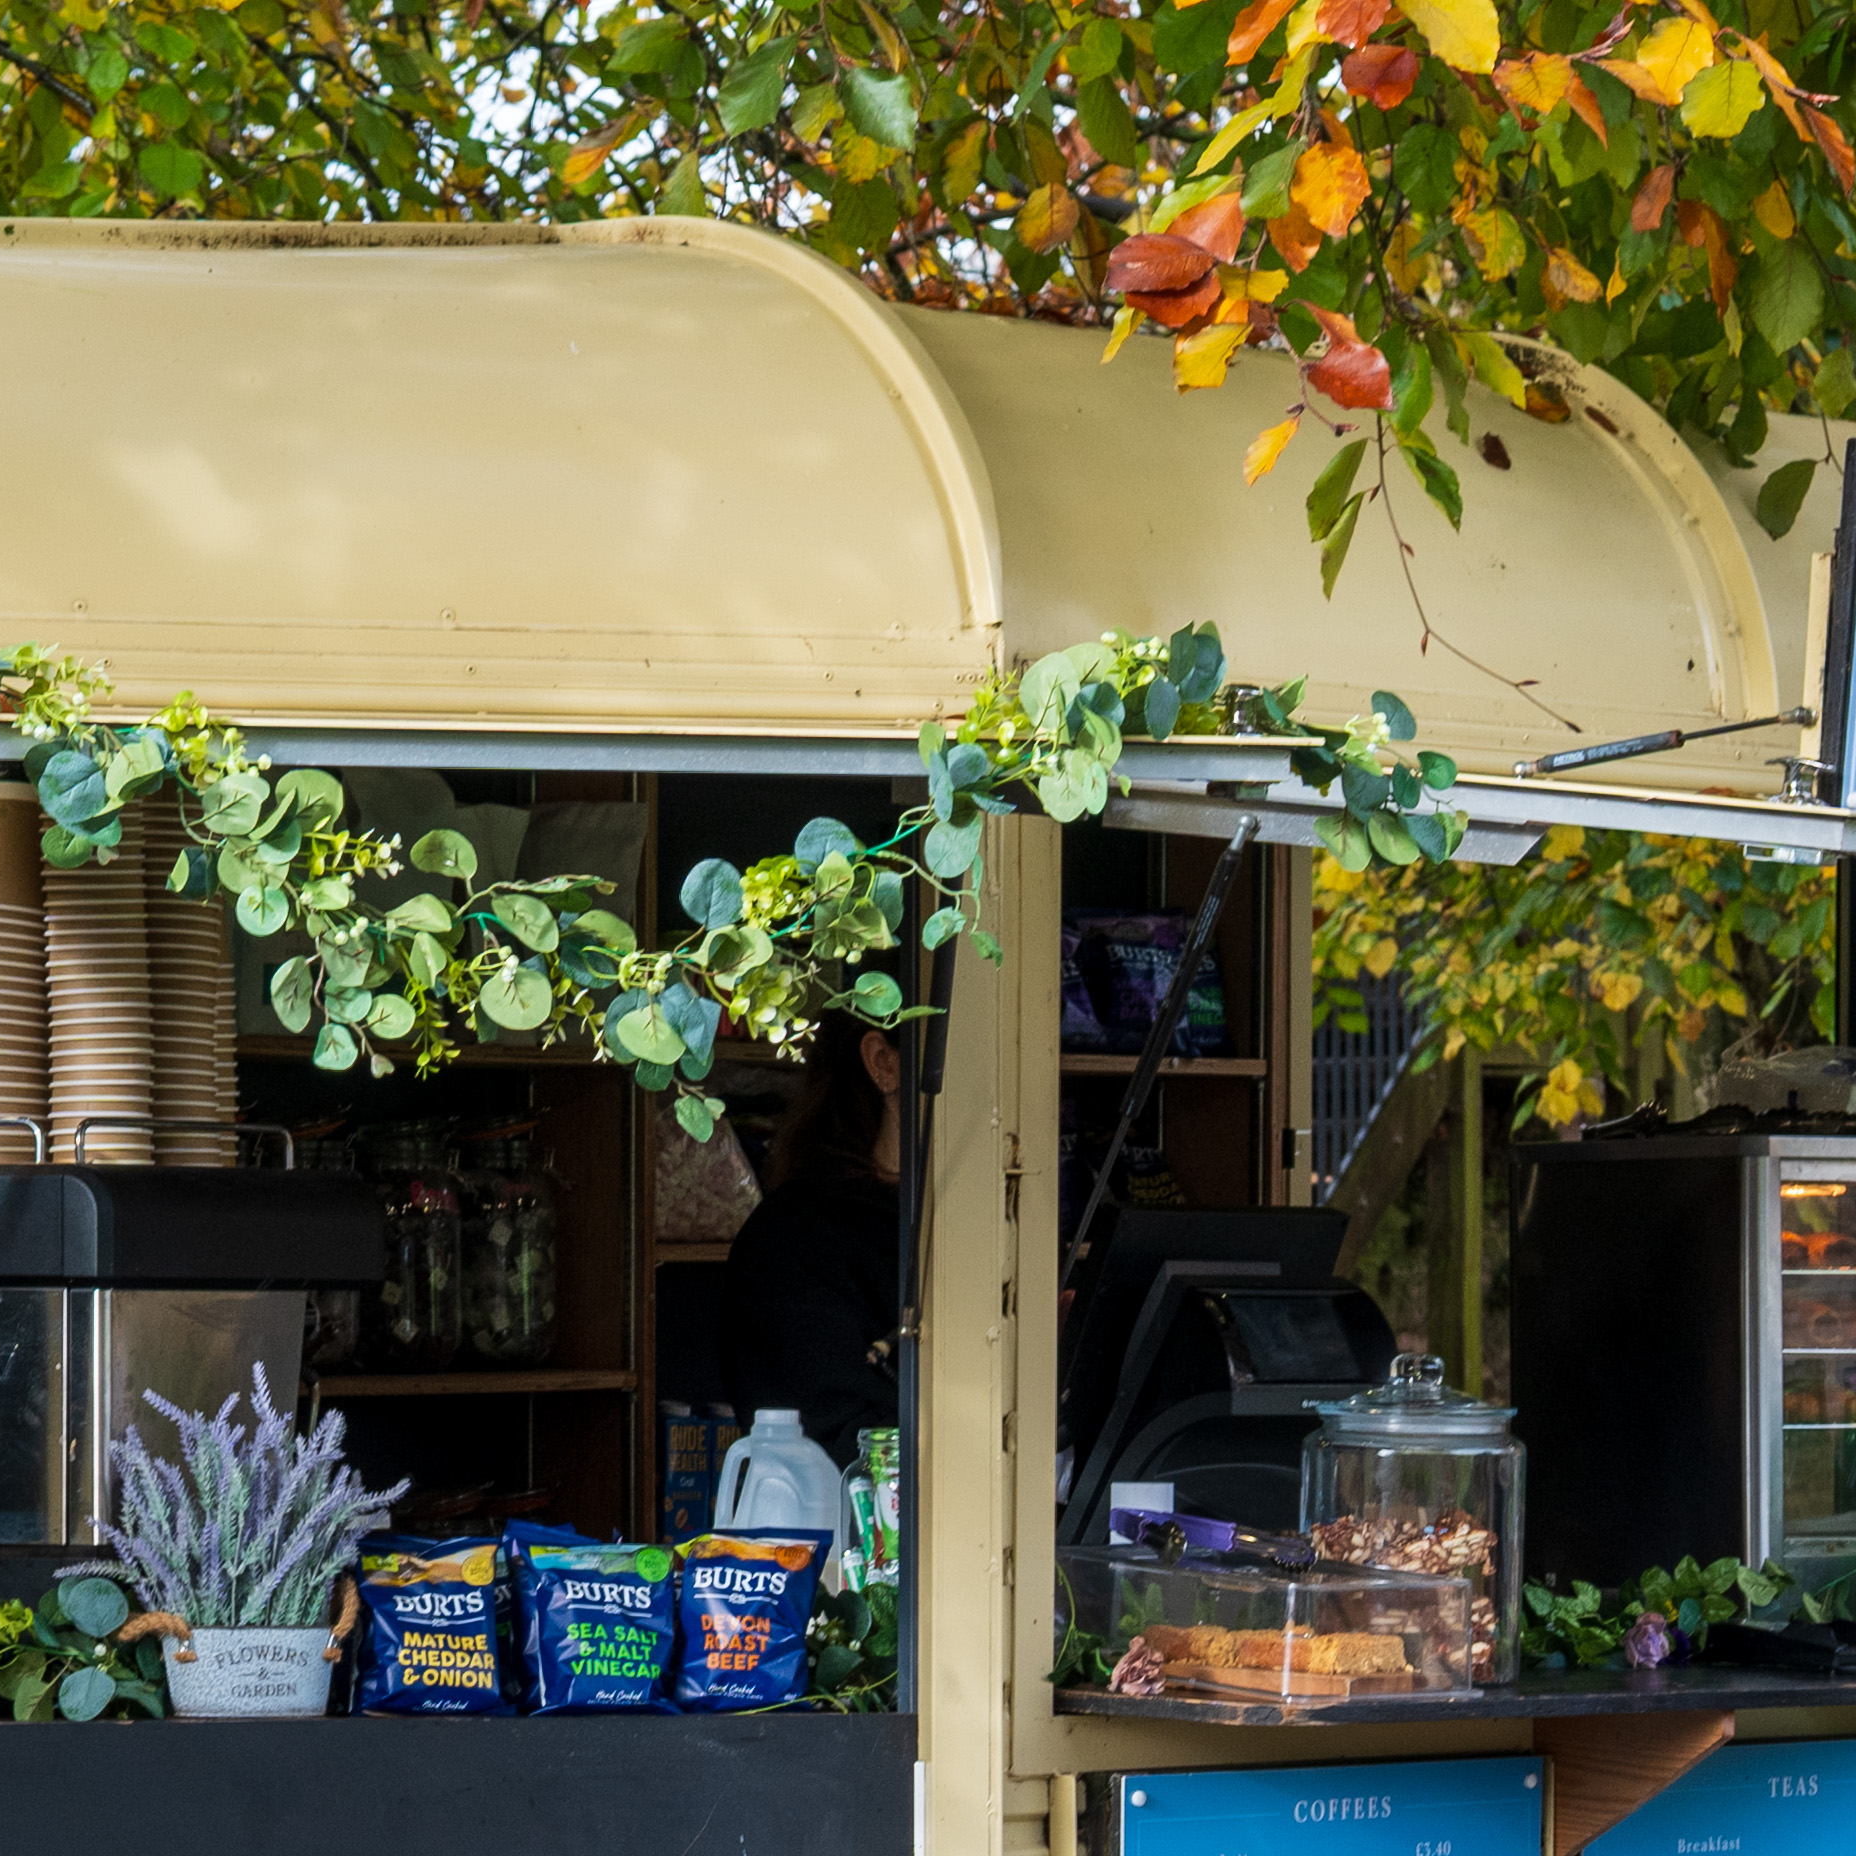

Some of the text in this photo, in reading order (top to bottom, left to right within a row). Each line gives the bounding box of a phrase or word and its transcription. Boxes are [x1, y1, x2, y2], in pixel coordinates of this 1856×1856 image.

[669, 1425, 708, 1451] RUDE
[693, 1566, 789, 1595] BURTS
[393, 1588, 485, 1617] BURTS
[563, 1579, 653, 1609] BURTS
[701, 1614, 771, 1632] DEVON
[403, 1631, 489, 1651] MATURE
[566, 1622, 658, 1647] SEA SALT
[704, 1634, 771, 1653] ROAST
[214, 1645, 309, 1669] FLOWERS
[398, 1650, 495, 1670] CHEDDAR
[579, 1643, 652, 1661] & MALT
[706, 1653, 761, 1672] BEEF
[257, 1666, 271, 1681] &
[422, 1668, 494, 1690] ONION
[570, 1658, 661, 1680] VINEGAR
[231, 1683, 297, 1698] GARDEN
[1768, 1774, 1819, 1798] TEAS
[1293, 1796, 1392, 1823] COFFEES
[1677, 1836, 1741, 1854] Breakfast
